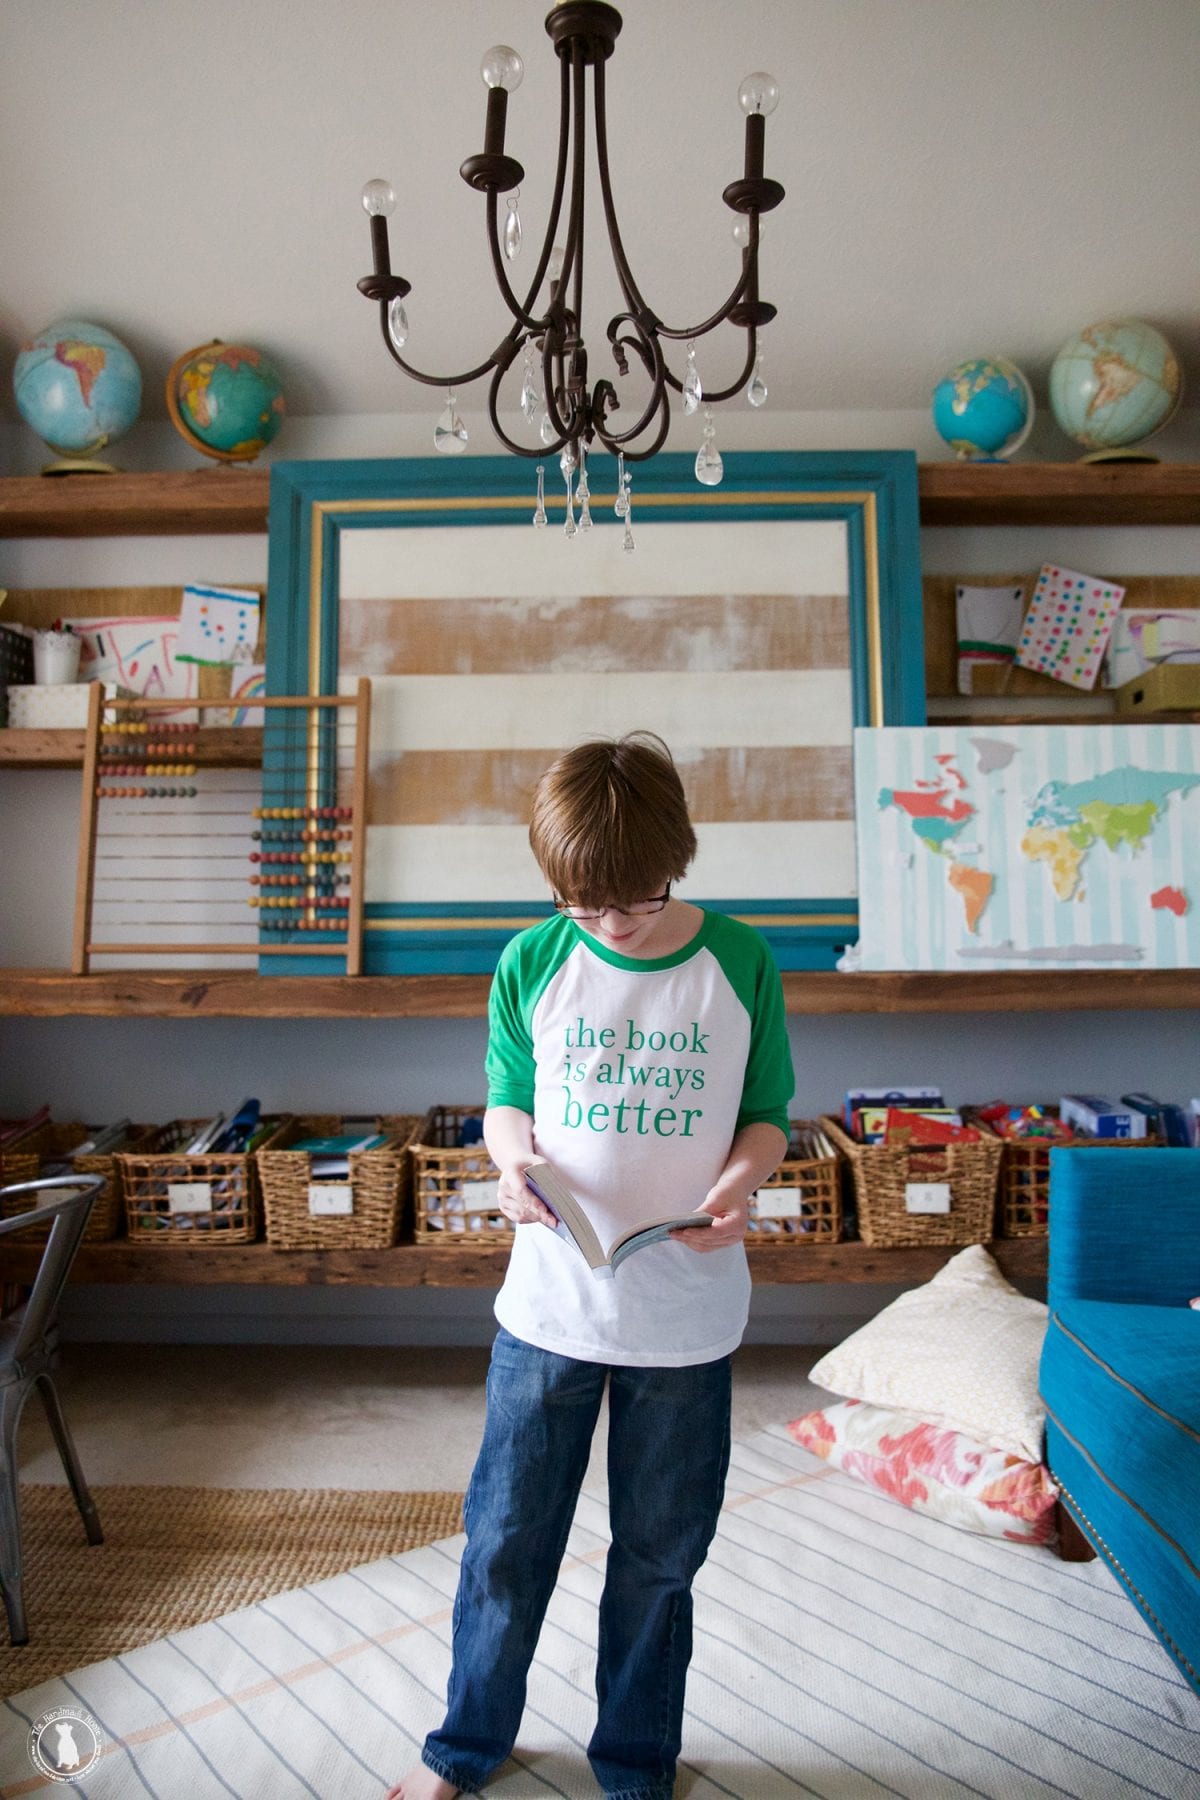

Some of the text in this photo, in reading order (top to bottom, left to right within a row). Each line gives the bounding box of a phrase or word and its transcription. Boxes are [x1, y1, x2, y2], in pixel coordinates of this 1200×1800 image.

[564, 1017, 711, 1054] the book
[562, 1053, 705, 1100] is always
[560, 1085, 704, 1137] better
